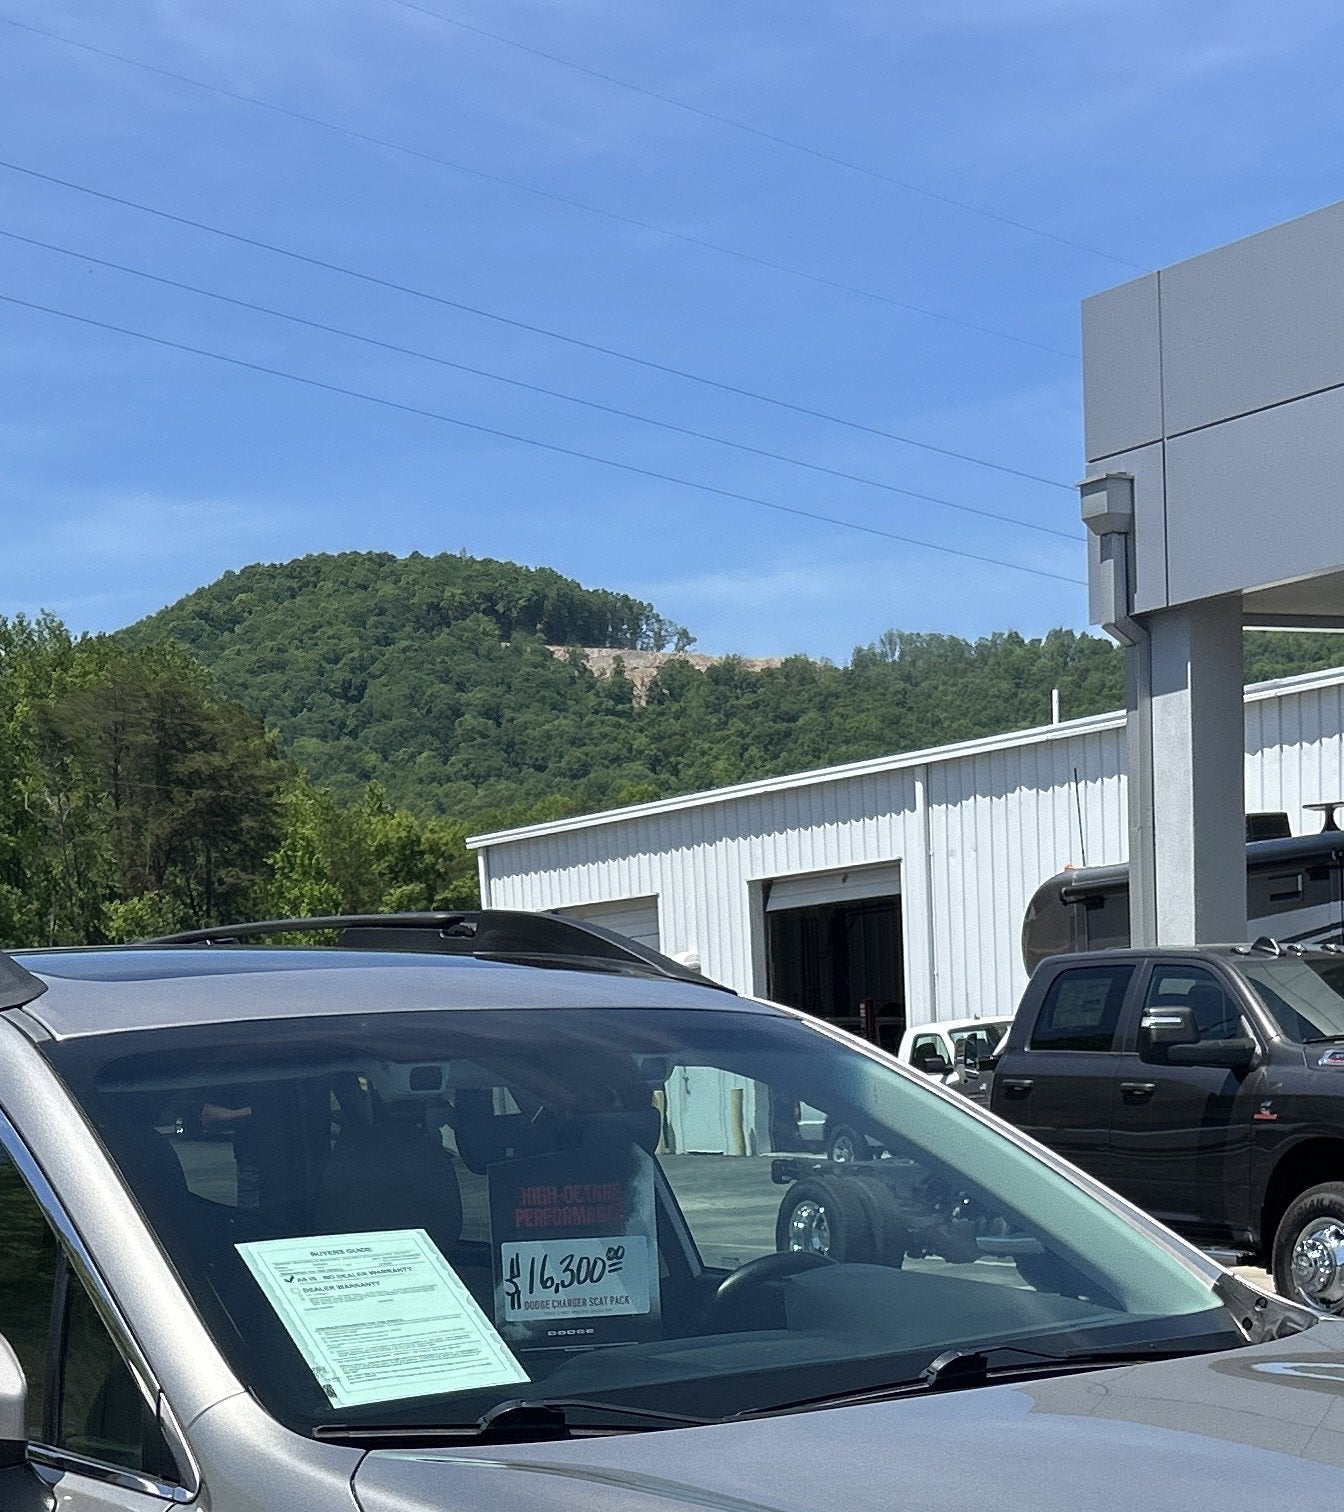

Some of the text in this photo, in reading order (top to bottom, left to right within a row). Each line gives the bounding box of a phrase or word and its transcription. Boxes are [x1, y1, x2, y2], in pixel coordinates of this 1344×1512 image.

[303, 1280, 380, 1293] DEALER WARRANTY
[524, 1295, 630, 1311] DODGE CHARGER SCAT PACK
